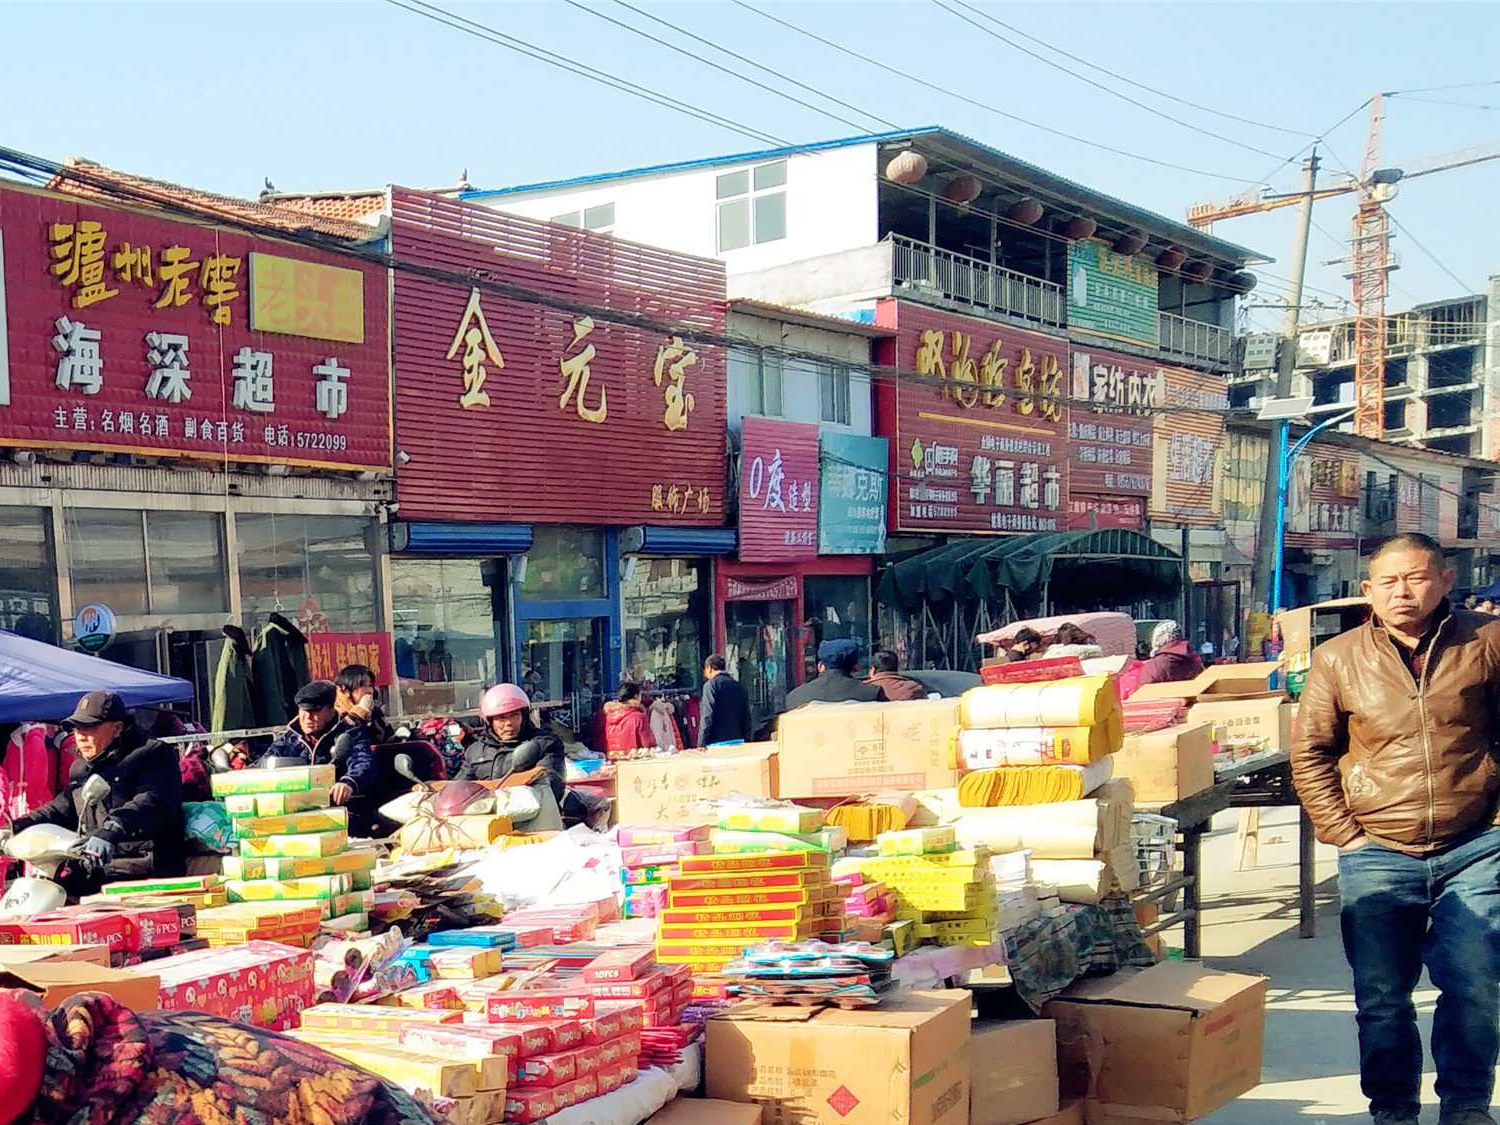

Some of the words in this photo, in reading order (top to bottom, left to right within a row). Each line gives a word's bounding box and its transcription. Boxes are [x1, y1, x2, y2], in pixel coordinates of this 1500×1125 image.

[53, 315, 352, 420] 海深超市
[446, 287, 698, 431] 金元宝
[184, 417, 245, 444] 副食百货
[970, 455, 1062, 511] 华丽超市
[162, 922, 178, 934] PCS
